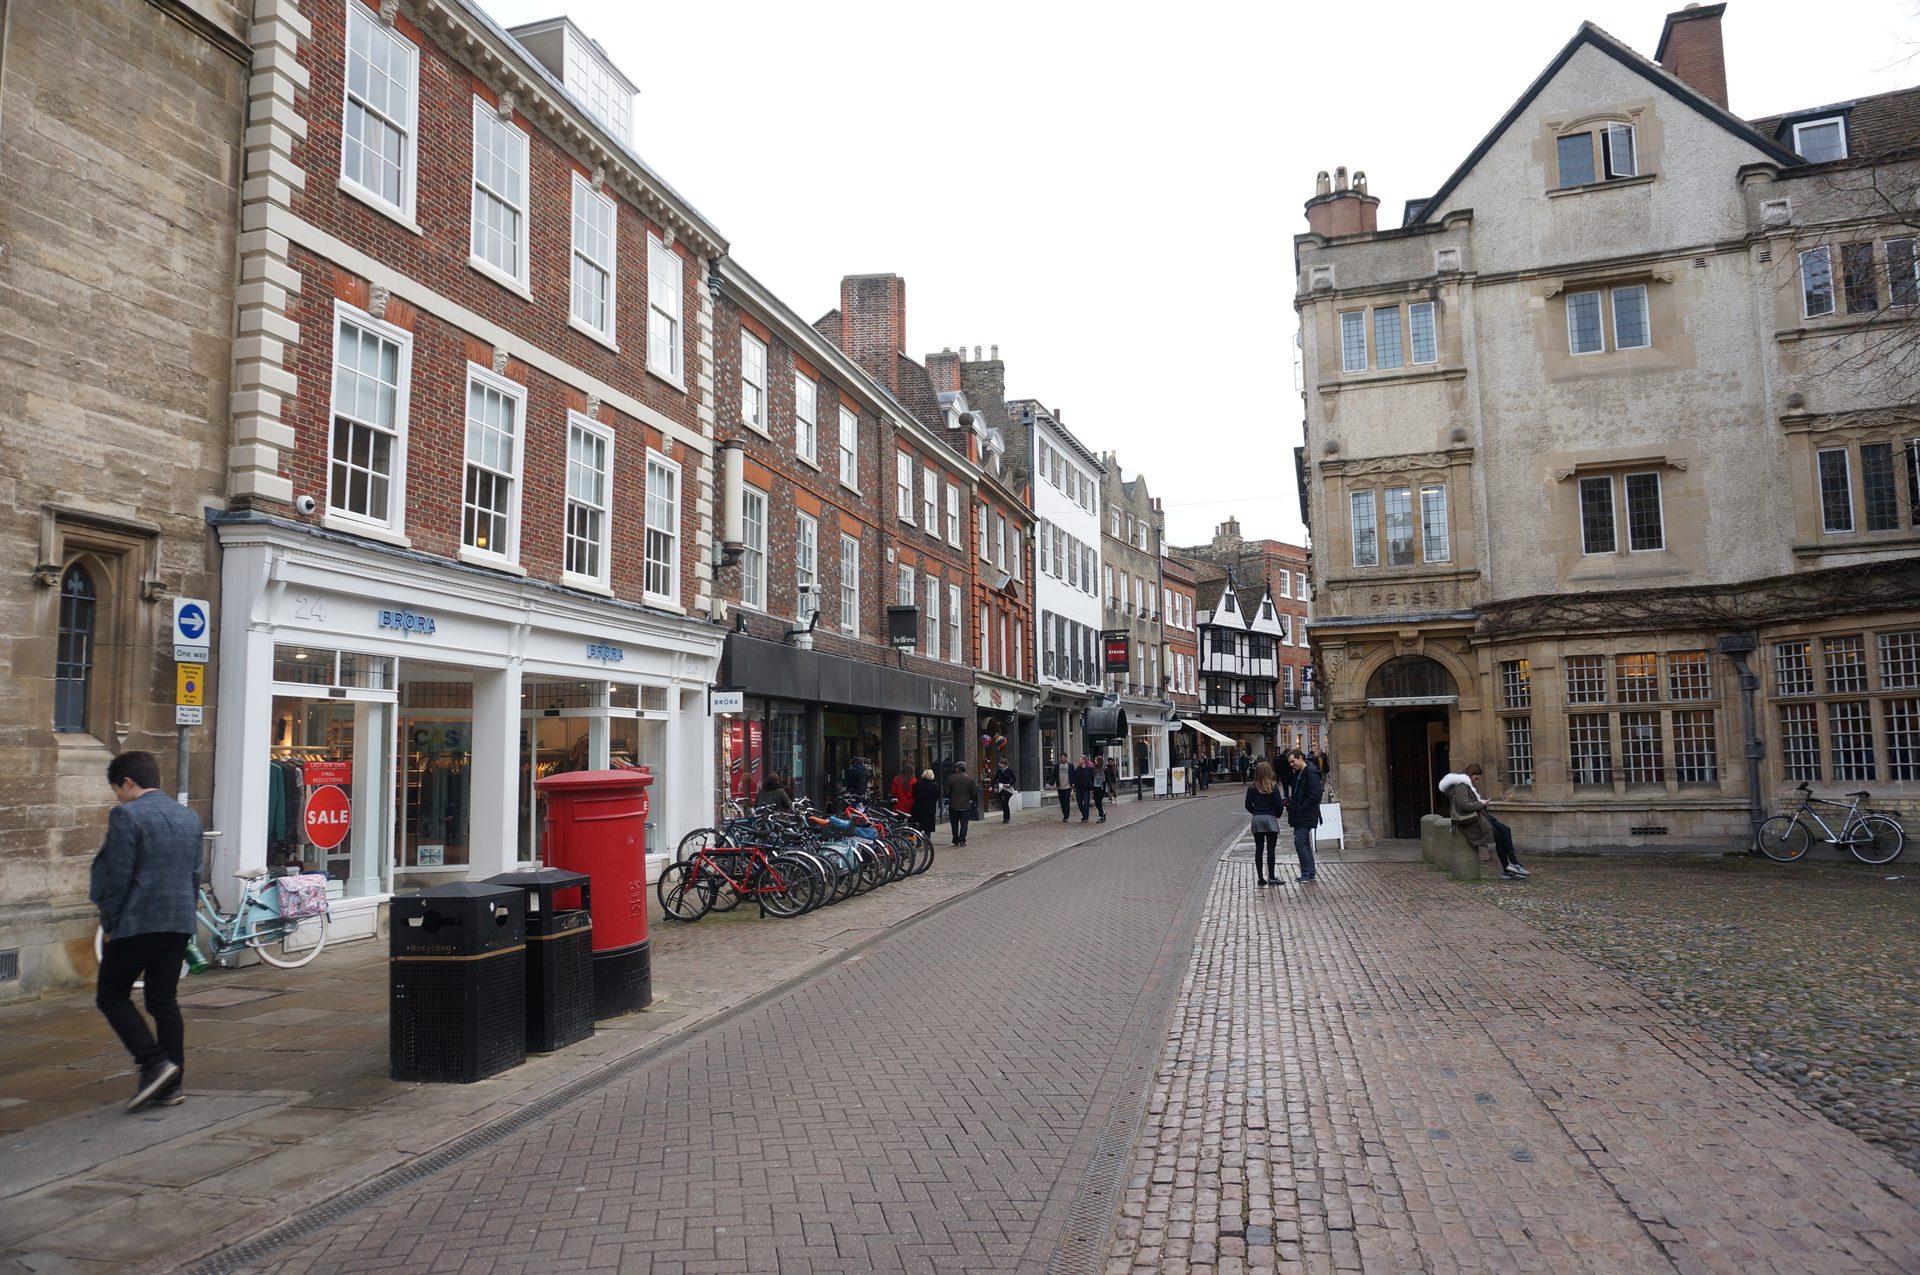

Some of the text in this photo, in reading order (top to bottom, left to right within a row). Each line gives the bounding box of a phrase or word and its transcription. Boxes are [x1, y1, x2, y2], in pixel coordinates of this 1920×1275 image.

[1371, 591, 1438, 606] REISS
[295, 593, 325, 621] 24
[381, 610, 437, 633] BRORA
[177, 649, 206, 660] One way
[588, 643, 623, 661] BRORA
[714, 698, 739, 706] BRORA
[307, 810, 348, 825] SALE
[410, 944, 452, 954] Recycling
